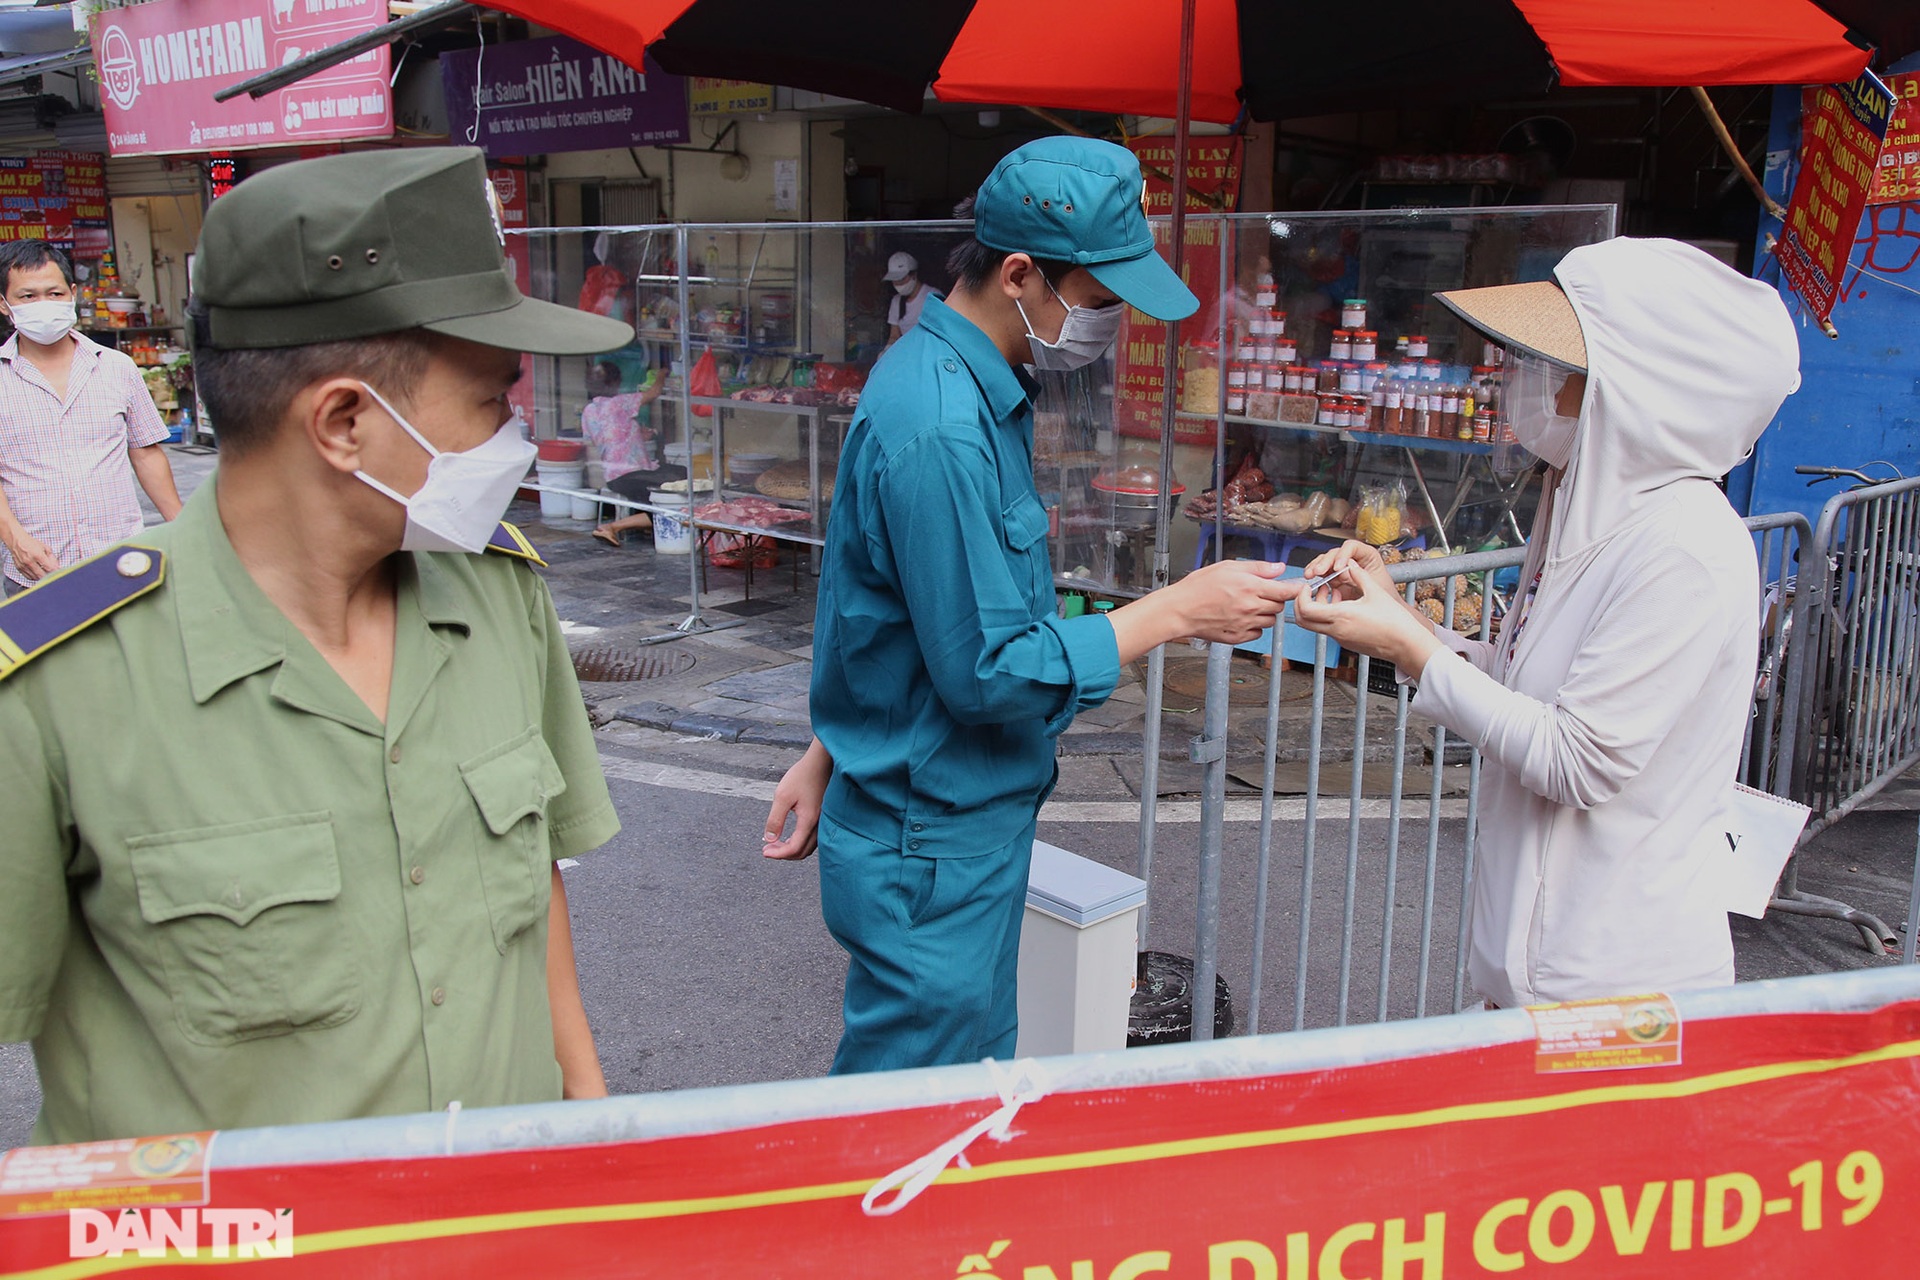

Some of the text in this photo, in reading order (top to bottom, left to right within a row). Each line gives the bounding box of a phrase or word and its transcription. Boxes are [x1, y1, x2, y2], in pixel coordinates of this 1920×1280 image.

[138, 16, 267, 86] HOMEFARM
[495, 80, 526, 102] Salon
[525, 46, 584, 104] HIỀN
[589, 54, 648, 98] ANH
[1856, 79, 1886, 120] LAN
[1889, 77, 1918, 101] La
[558, 111, 572, 127] TÓC
[604, 104, 634, 125] NGHIỆP
[1135, 145, 1191, 161] CHÍN
[1855, 131, 1877, 159] SẢN
[19, 170, 43, 186] TÉP
[1878, 183, 1909, 198] 430
[1820, 203, 1839, 236] TÔM
[18, 225, 46, 239] QUAY
[1811, 264, 1828, 288] BÁN
[1473, 1149, 1884, 1273] COVID-19
